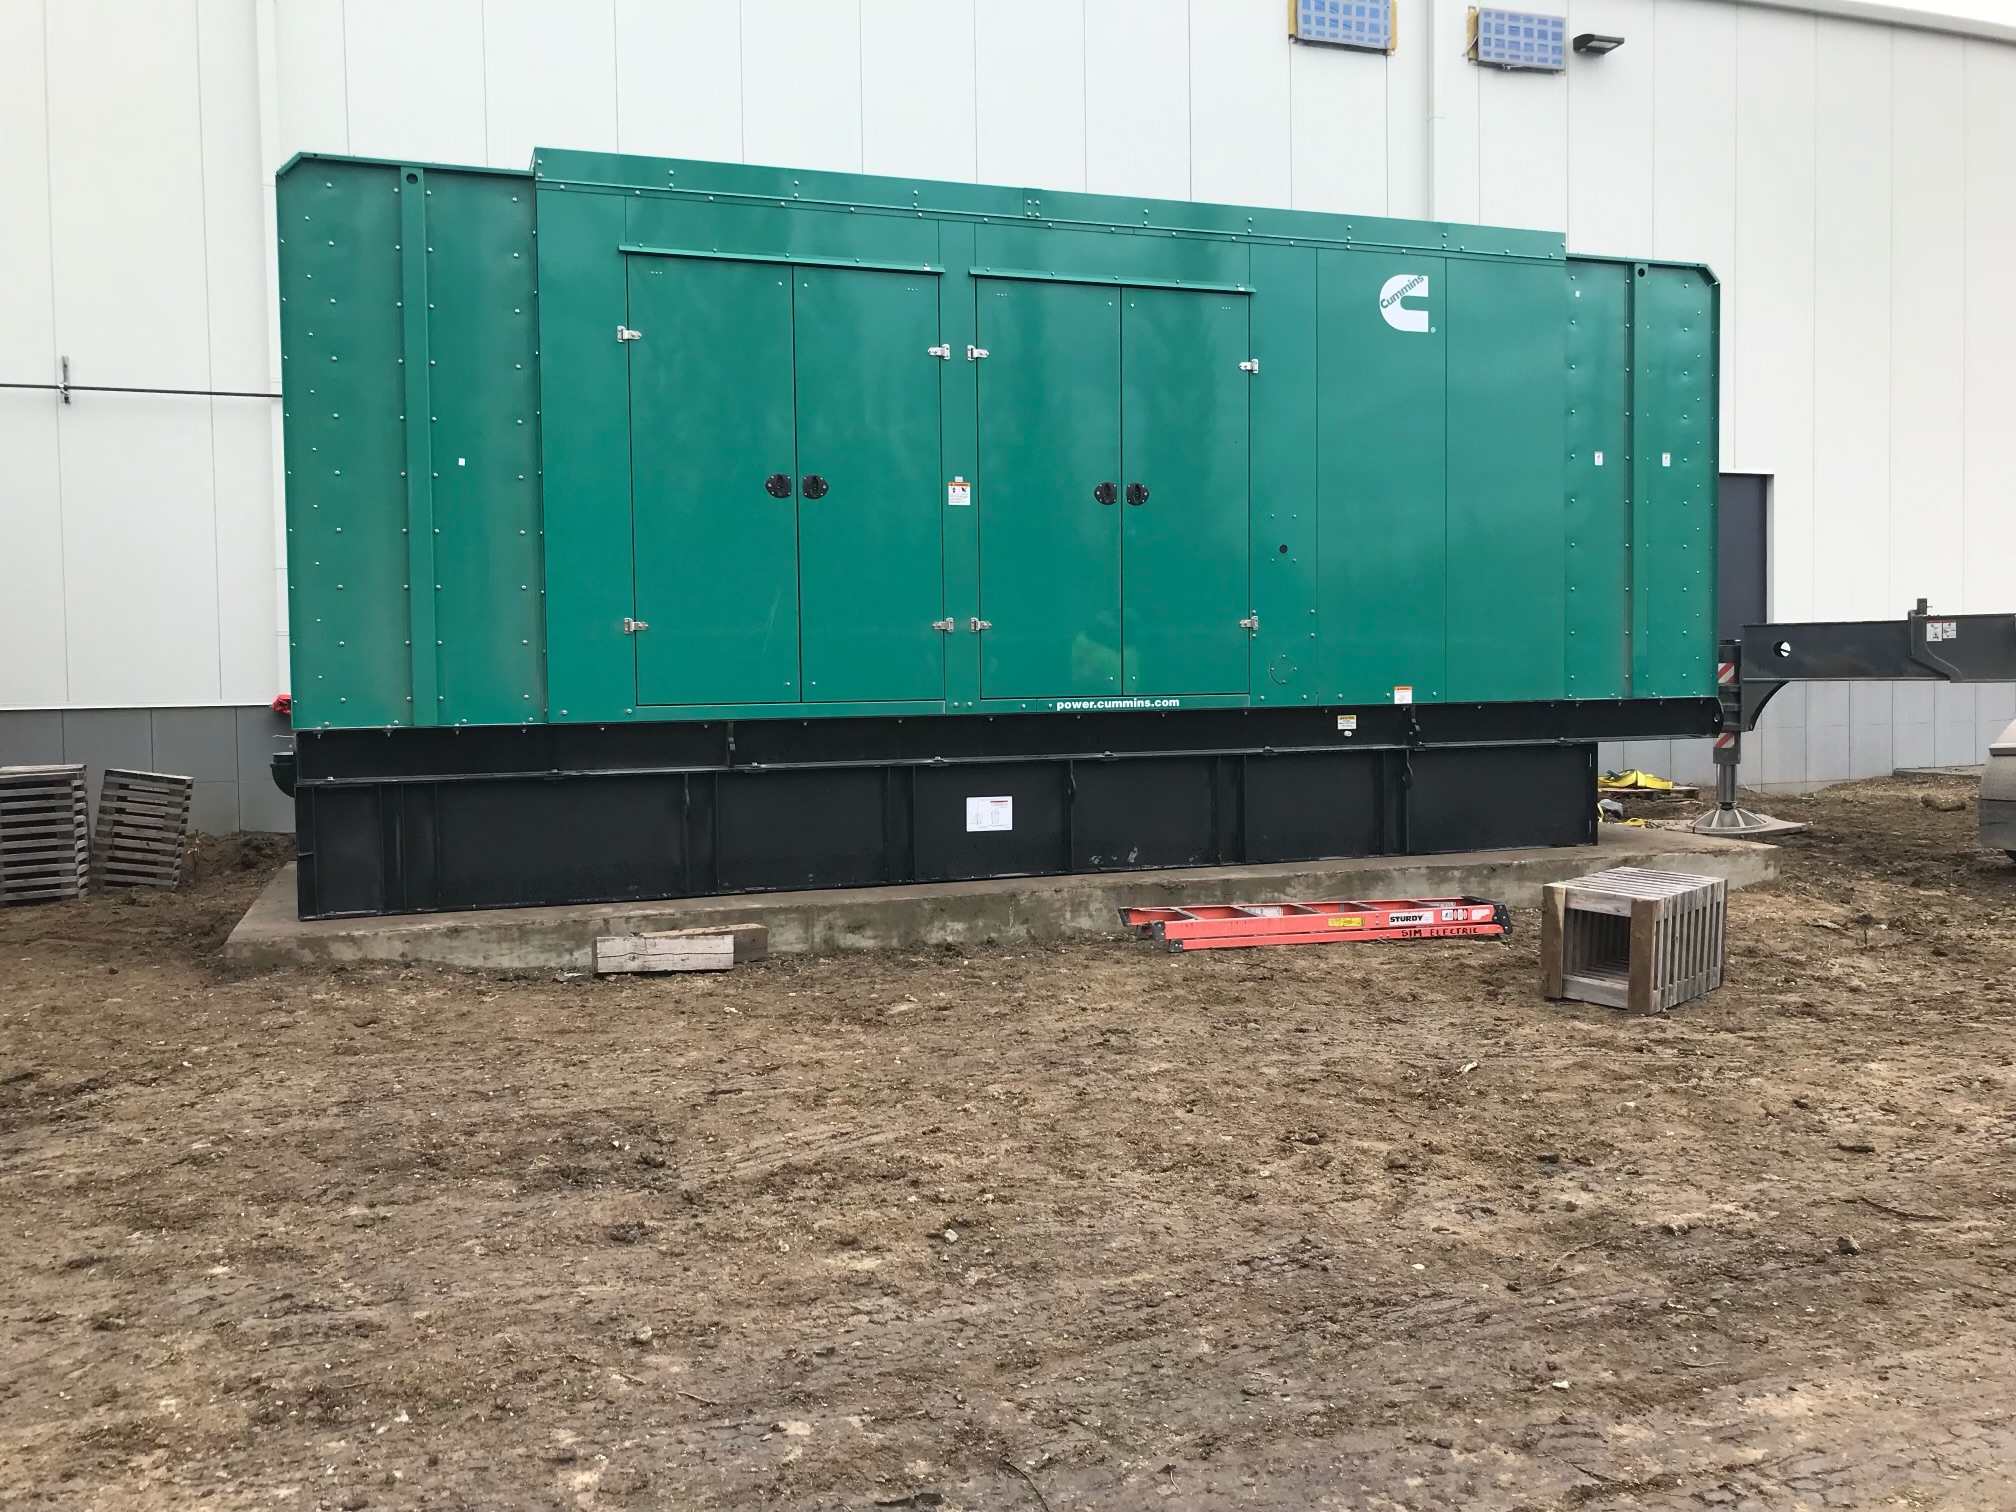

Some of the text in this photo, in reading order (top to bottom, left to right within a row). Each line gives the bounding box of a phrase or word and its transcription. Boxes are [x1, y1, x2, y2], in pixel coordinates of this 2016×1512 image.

[1380, 275, 1424, 309] Cummins
[1056, 698, 1180, 711] power.cummins.com
[1390, 915, 1424, 923] STURDY
[1430, 927, 1478, 936] ELECTRIC
